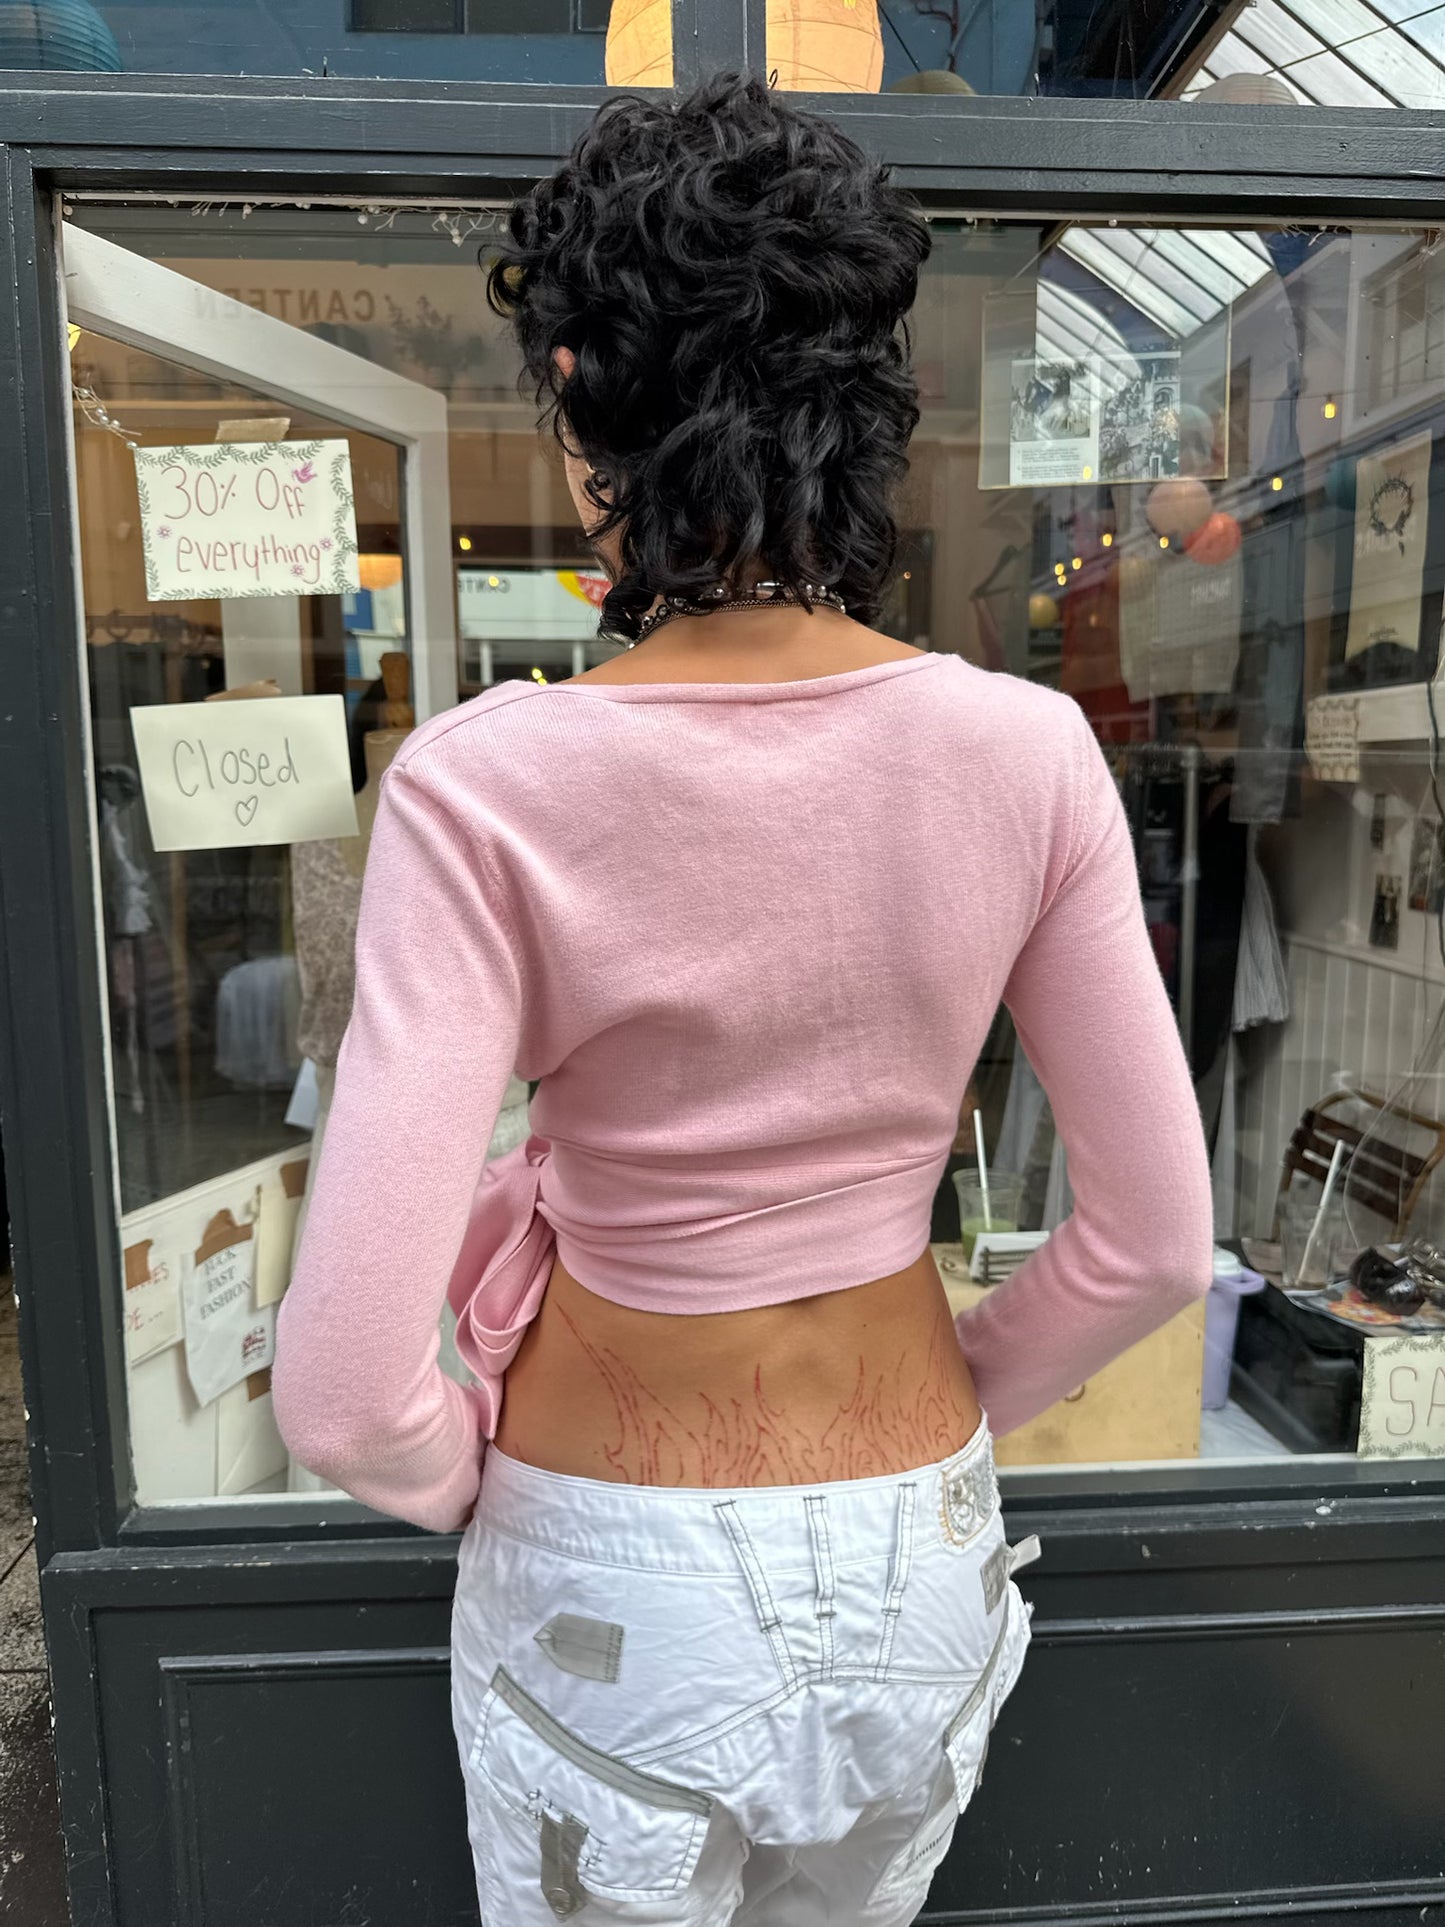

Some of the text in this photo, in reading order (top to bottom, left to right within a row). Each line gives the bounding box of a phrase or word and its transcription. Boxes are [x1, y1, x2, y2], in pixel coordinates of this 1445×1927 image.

[161, 465, 305, 520] 30% Off
[176, 534, 321, 585] everything
[172, 737, 300, 797] Closed
[207, 1265, 236, 1294] FAST
[1385, 1365, 1445, 1436] SA
